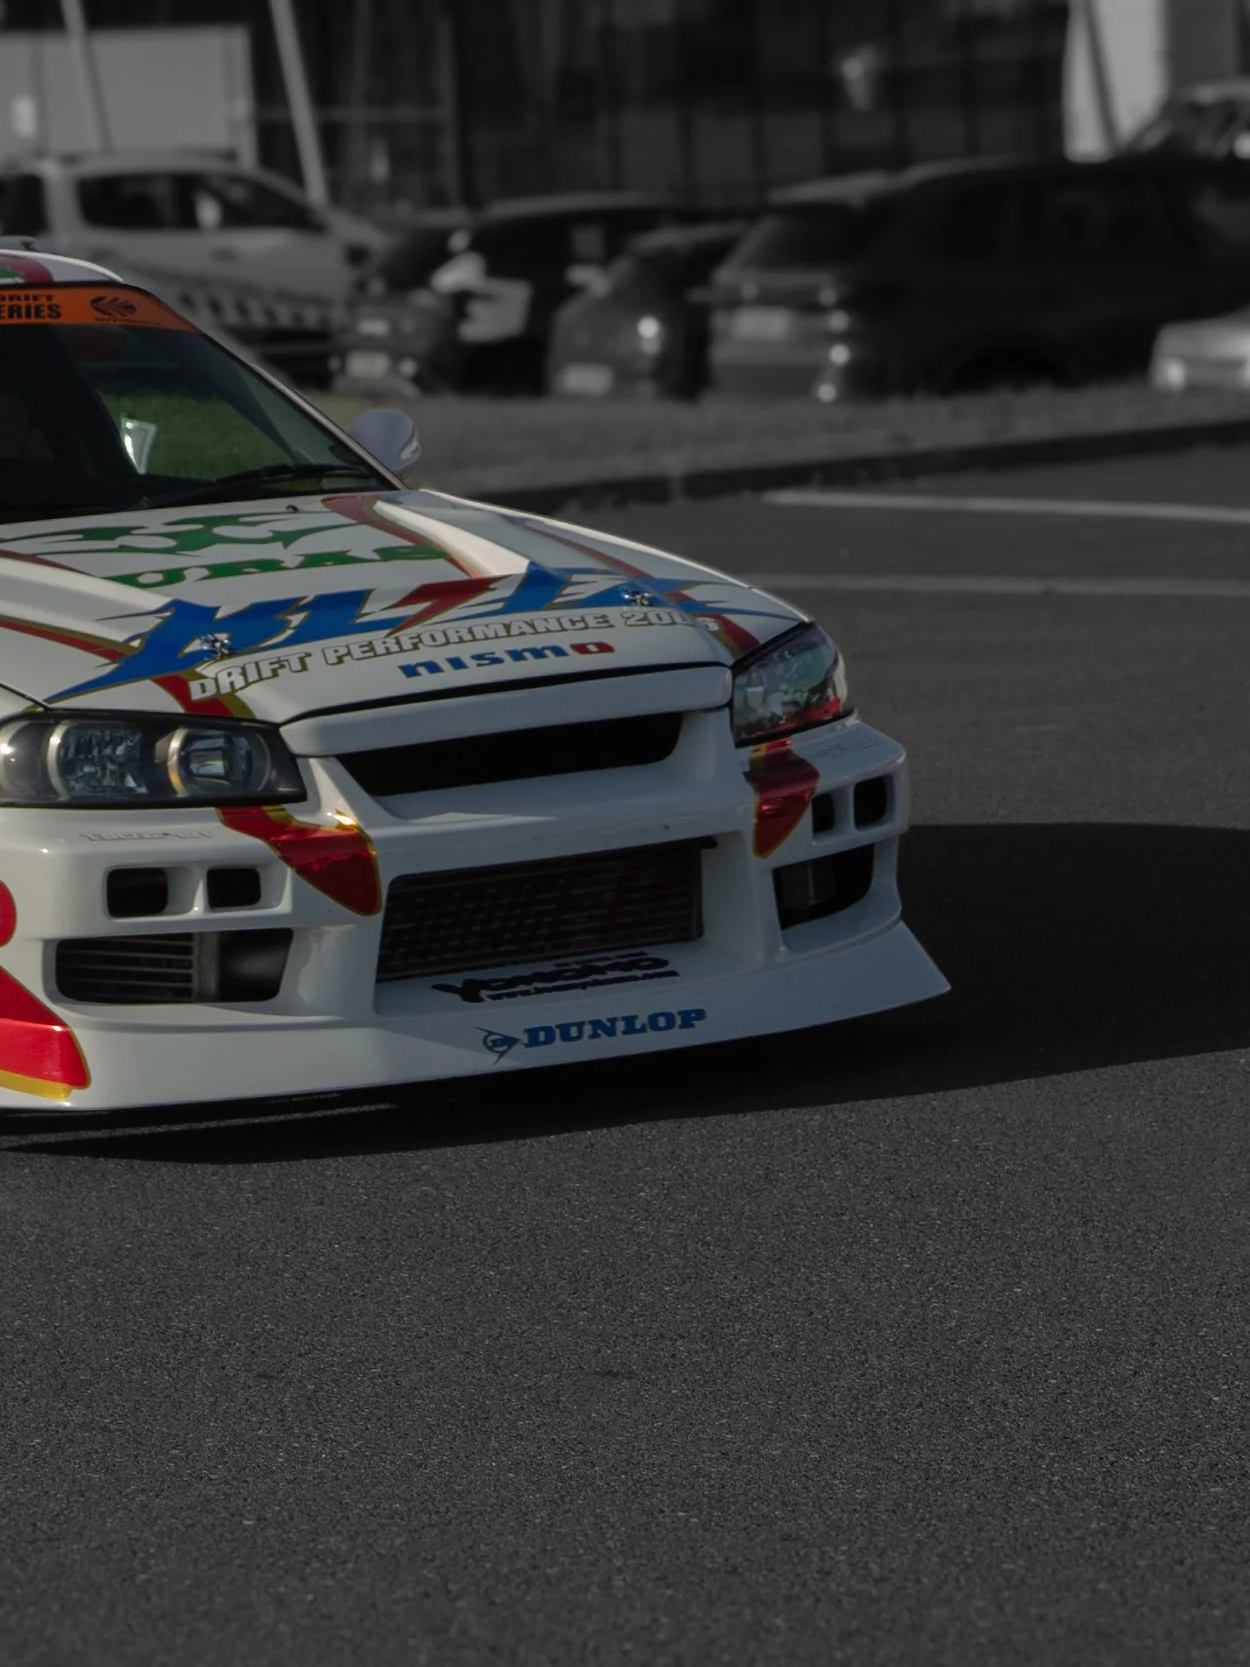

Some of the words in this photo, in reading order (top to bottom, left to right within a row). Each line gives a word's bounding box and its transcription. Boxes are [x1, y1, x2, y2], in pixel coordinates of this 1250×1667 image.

[189, 650, 315, 703] DRIFT
[323, 612, 616, 666] PERFORMANCE
[523, 1007, 707, 1049] DUNLOP
